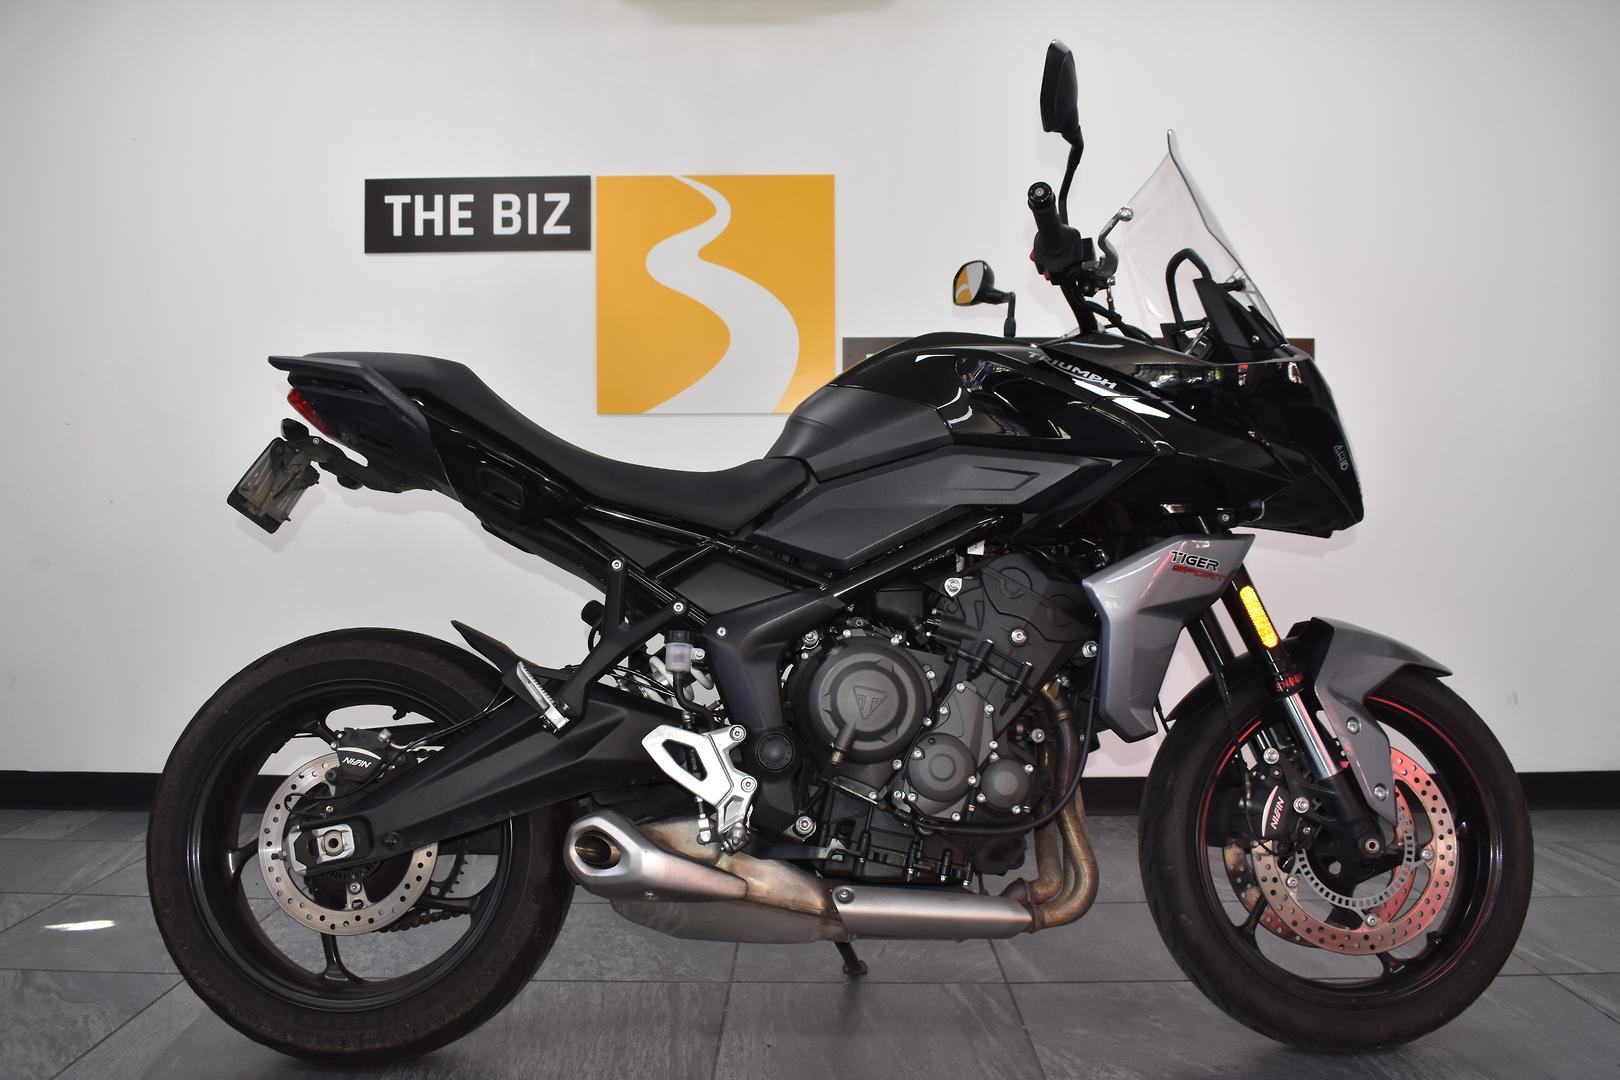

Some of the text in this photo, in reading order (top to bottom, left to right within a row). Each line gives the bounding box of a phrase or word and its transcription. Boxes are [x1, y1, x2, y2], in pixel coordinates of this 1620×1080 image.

[384, 193, 571, 236] THE BIZ
[1028, 351, 1118, 389] TRIUMPH
[1170, 551, 1219, 571] TIGER
